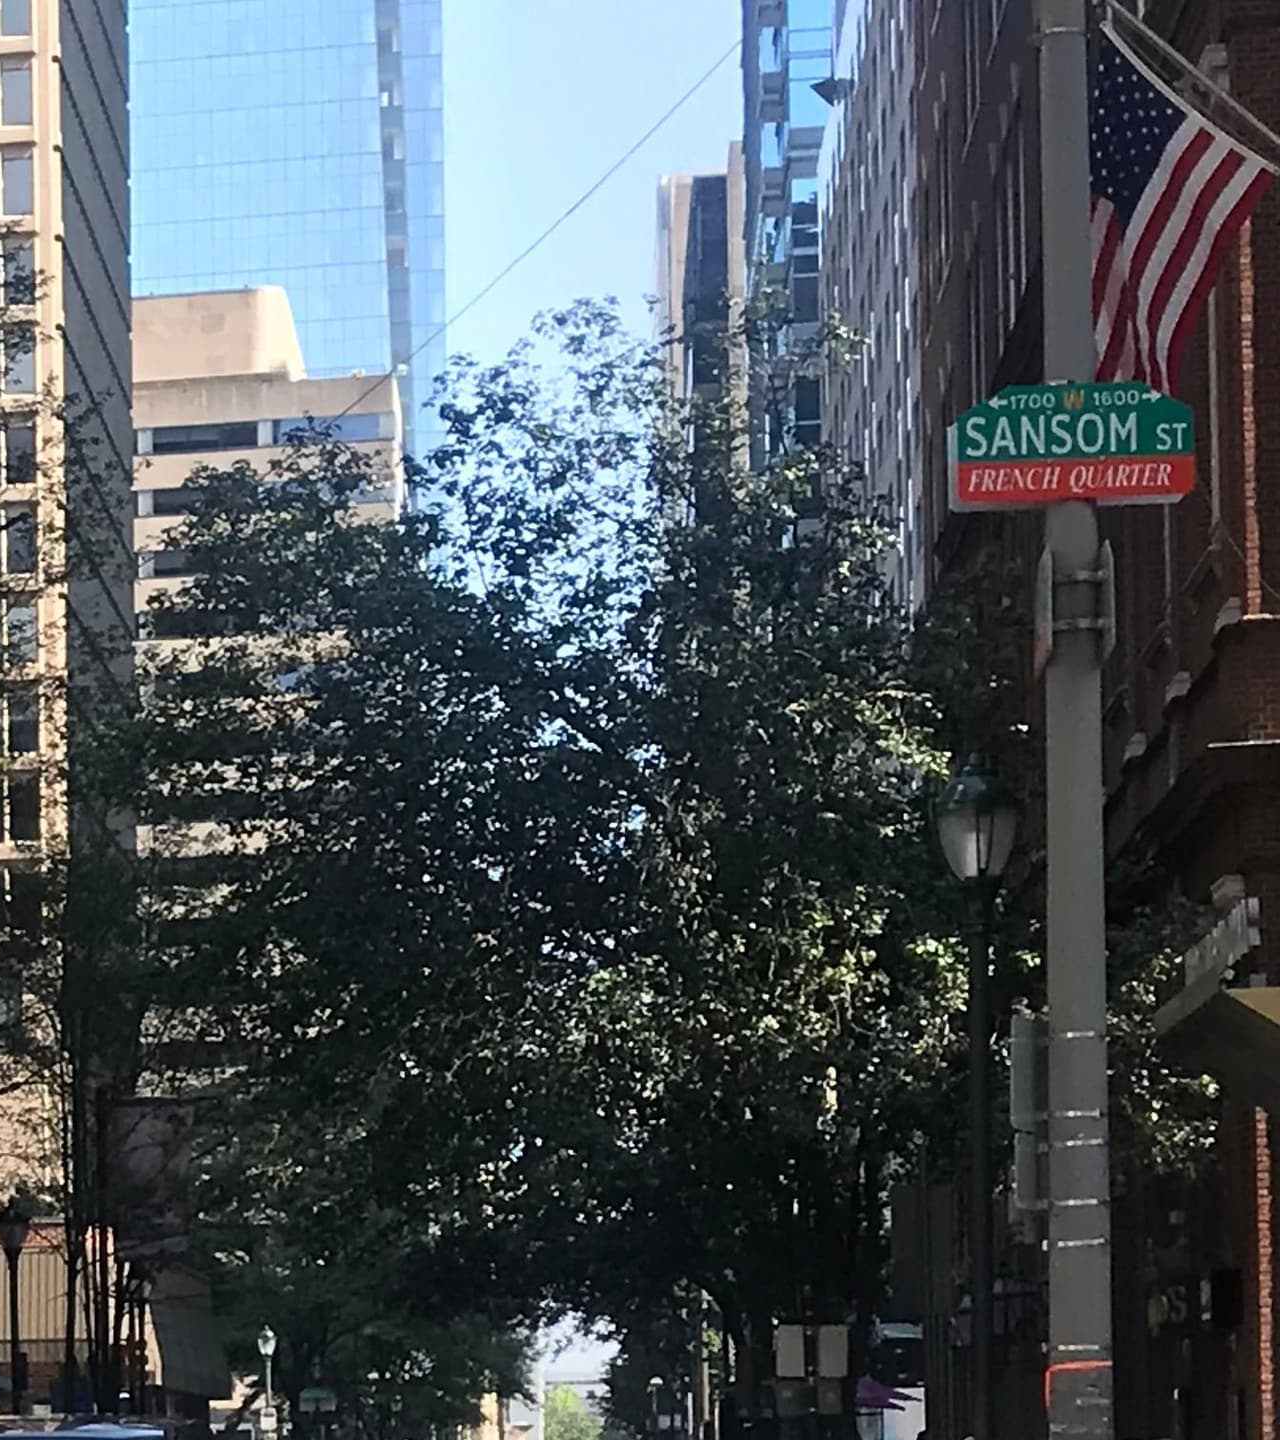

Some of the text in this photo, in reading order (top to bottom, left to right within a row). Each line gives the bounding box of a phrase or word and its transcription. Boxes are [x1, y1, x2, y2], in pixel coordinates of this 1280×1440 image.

[1010, 394, 1056, 410] 1700
[1093, 389, 1140, 406] 1600
[965, 412, 1188, 457] SANSOM ST
[968, 463, 1173, 493] FRENCH QUARTER
